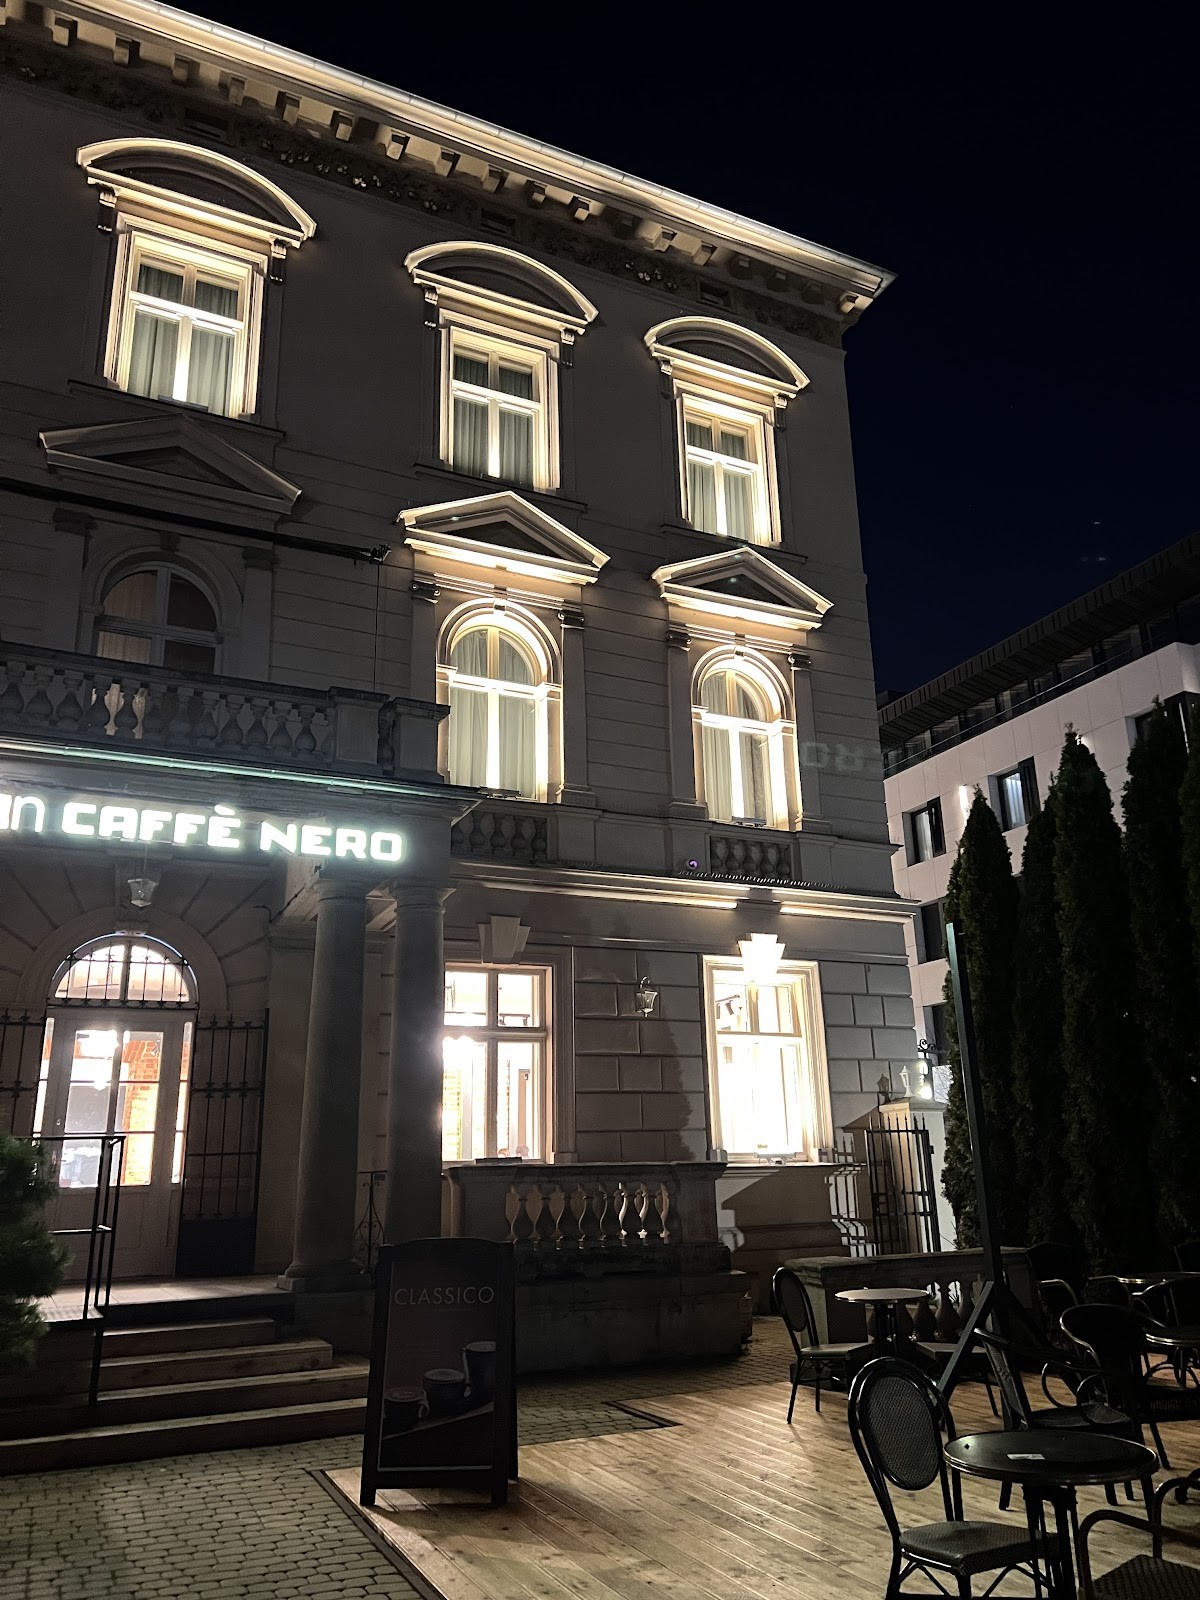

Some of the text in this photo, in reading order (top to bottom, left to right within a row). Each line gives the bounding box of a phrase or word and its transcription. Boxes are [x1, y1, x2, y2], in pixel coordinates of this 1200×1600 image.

[61, 801, 241, 849] CAFFÈ
[260, 821, 403, 862] NERO
[394, 1286, 495, 1306] CLASSICO
